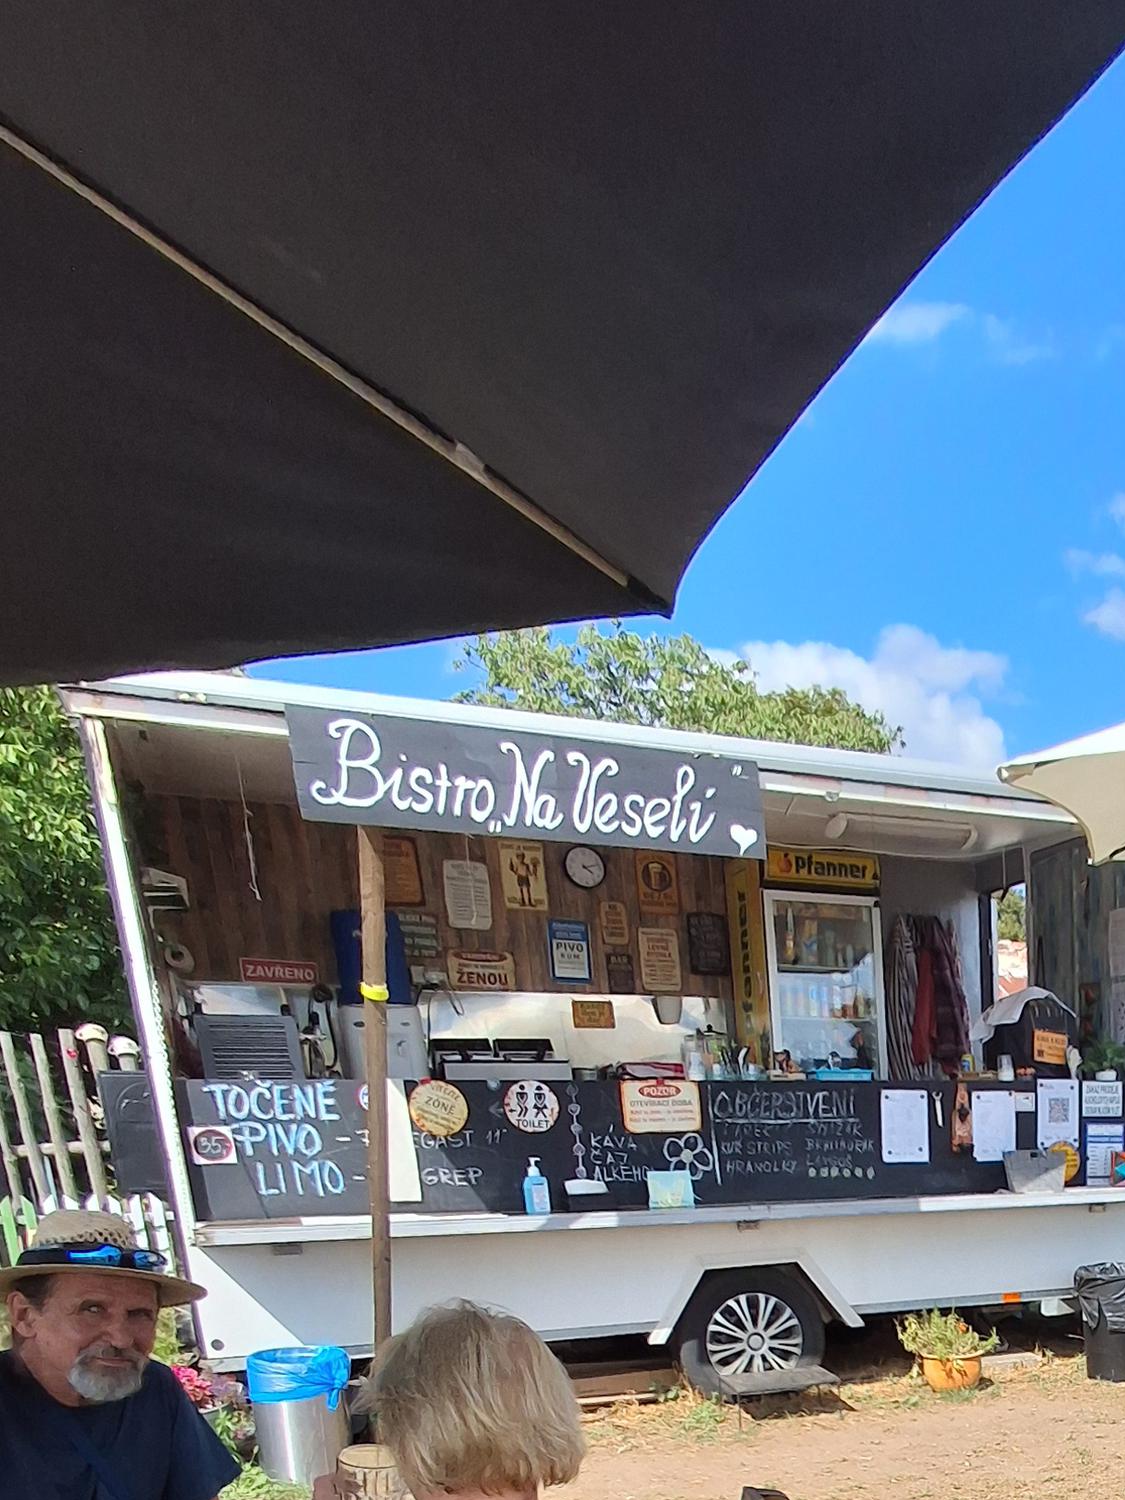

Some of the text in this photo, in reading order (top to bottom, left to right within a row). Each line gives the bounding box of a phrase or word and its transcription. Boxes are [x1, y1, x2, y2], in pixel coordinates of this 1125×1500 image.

[311, 718, 496, 823] Bistro
[795, 854, 867, 879] Pfanner
[556, 942, 584, 953] PIVO
[456, 968, 508, 985] ŽENOU
[201, 1080, 341, 1121] TOČENÉ
[643, 1086, 677, 1097] POZOR
[515, 1118, 551, 1129] TOILET
[231, 1121, 323, 1157] PIVO
[590, 1148, 628, 1165] ČAJ
[256, 1160, 346, 1197] LIMO
[421, 1167, 483, 1186] GREP
